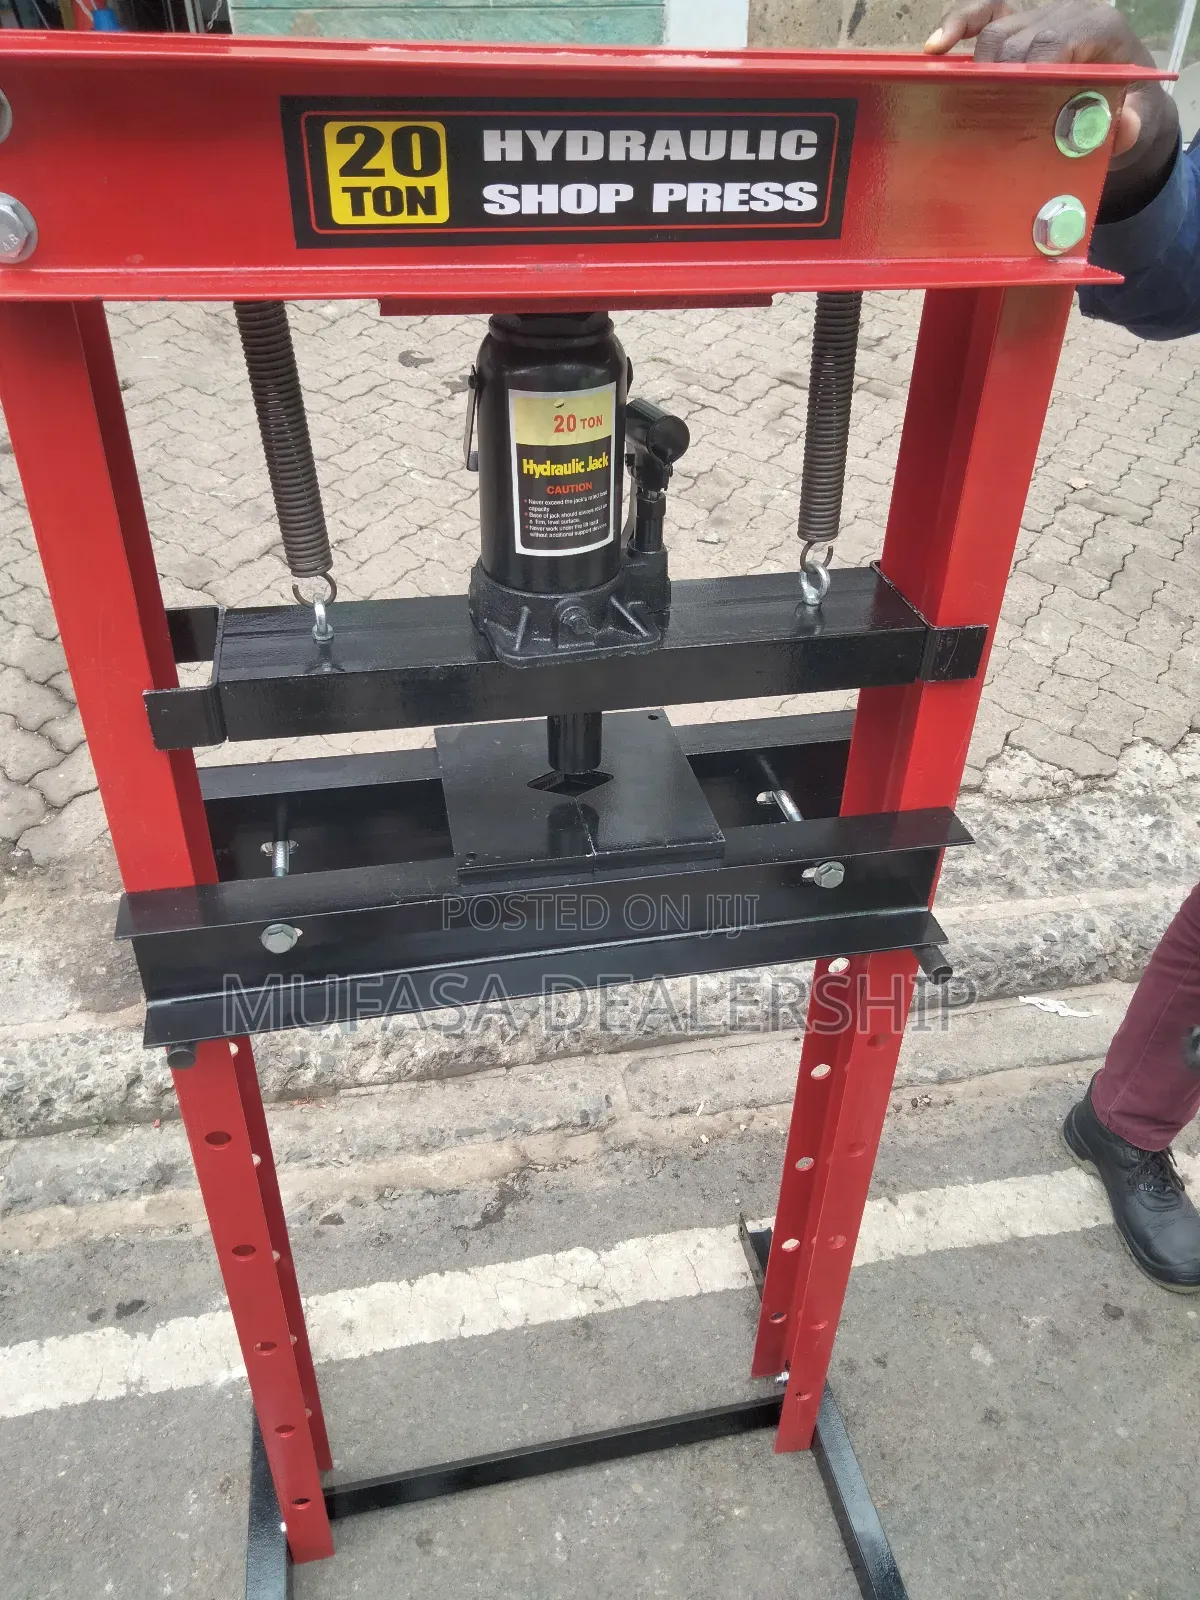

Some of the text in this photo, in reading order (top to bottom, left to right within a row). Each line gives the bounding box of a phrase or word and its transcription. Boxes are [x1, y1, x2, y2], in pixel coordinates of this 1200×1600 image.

[336, 125, 443, 178] 20
[482, 129, 818, 161] HYDRAULIC
[341, 185, 438, 217] TON
[482, 182, 818, 216] SHOP PRESS
[553, 413, 603, 433] 20 TON
[522, 452, 609, 479] Hydraulic Jack
[546, 482, 592, 495] CAUTION
[575, 528, 591, 536] support
